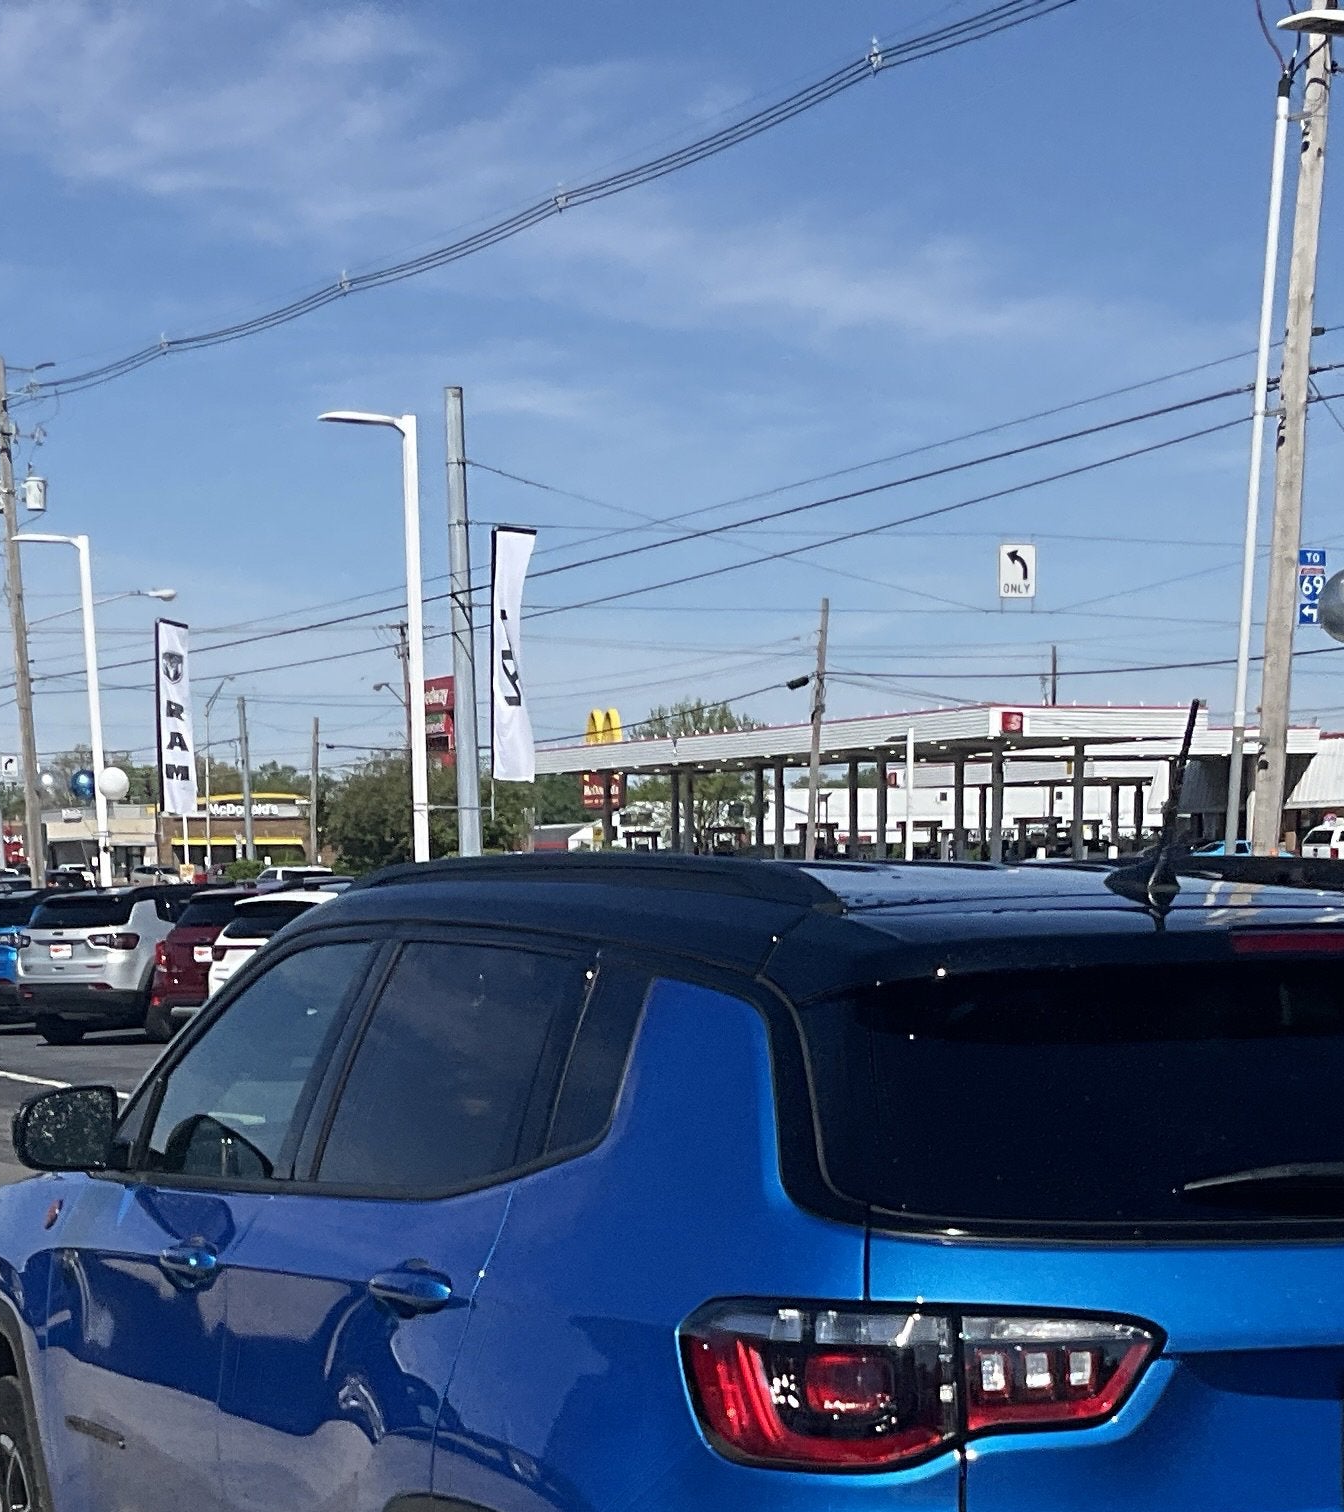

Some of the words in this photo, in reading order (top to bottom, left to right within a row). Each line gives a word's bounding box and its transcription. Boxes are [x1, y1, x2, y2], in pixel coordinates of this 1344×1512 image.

[1306, 552, 1319, 563] TO
[1003, 583, 1031, 594] ONLY
[1301, 576, 1324, 595] 69
[165, 700, 190, 781] RAM
[209, 803, 279, 815] McDoald's
